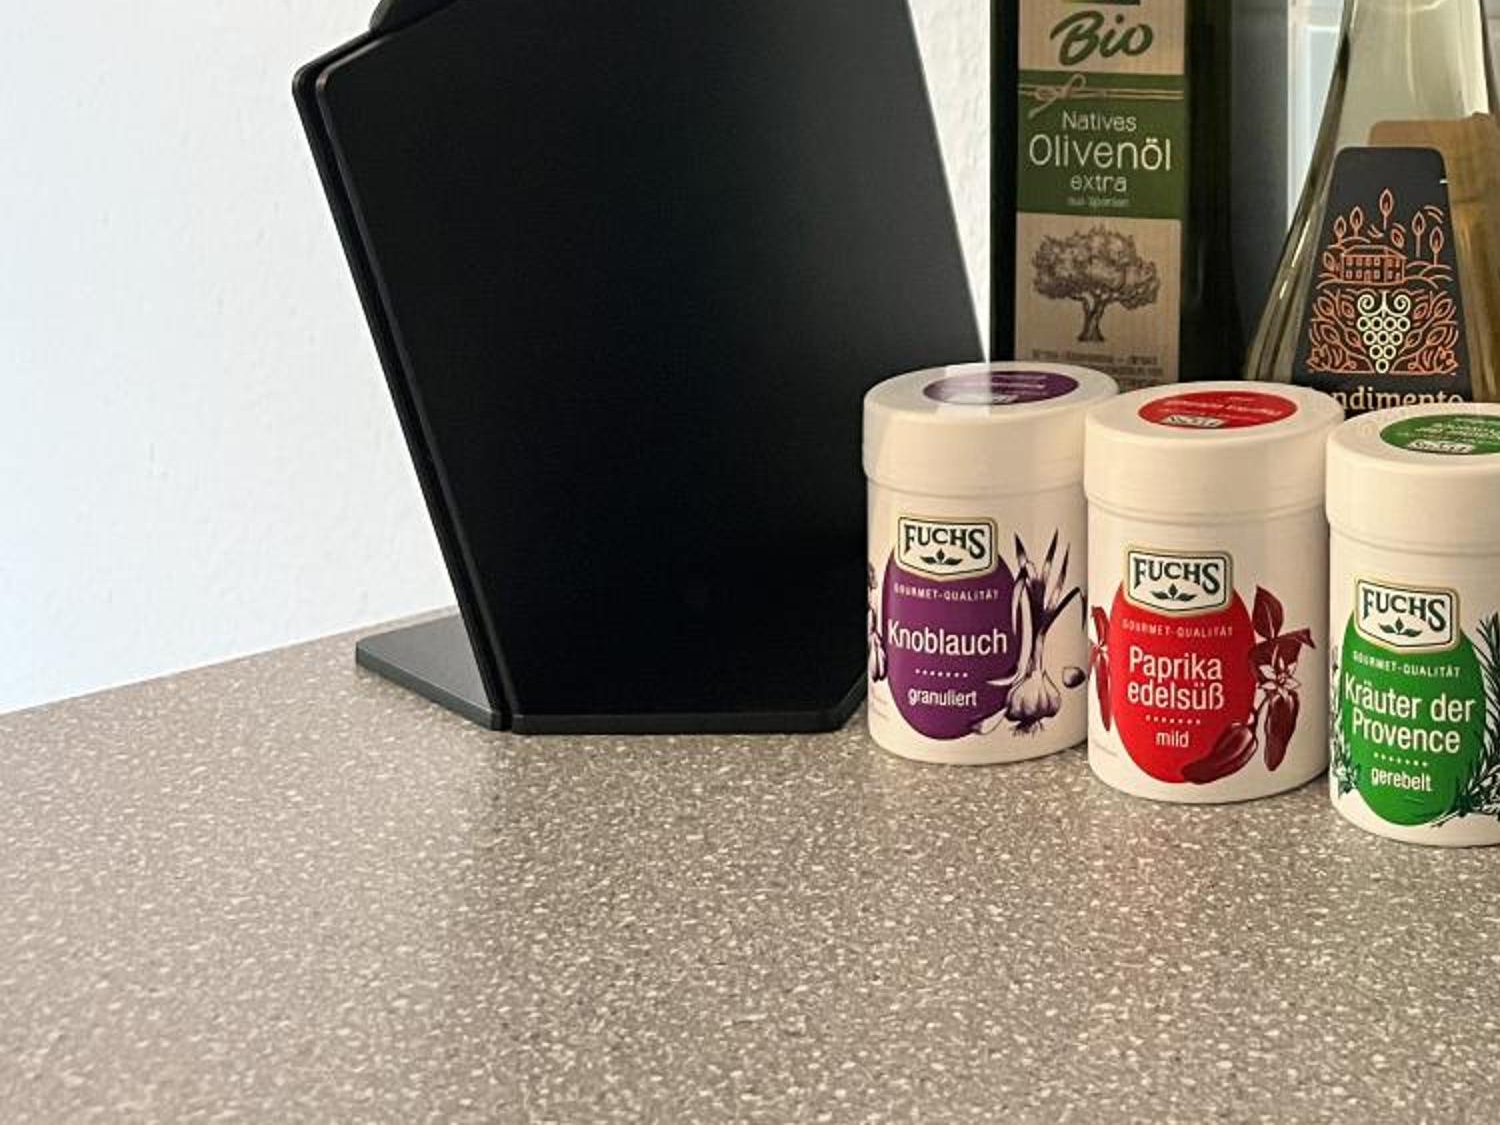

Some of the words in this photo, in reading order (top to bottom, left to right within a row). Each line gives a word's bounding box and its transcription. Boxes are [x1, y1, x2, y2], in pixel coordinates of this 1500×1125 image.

[1050, 10, 1154, 66] Bio
[1062, 111, 1137, 132] Natives
[1029, 134, 1171, 171] Olivenöl
[1071, 175, 1127, 193] extra
[1330, 386, 1464, 410] ndimento
[904, 525, 985, 559] FUCHS
[894, 582, 999, 601] GOURMET-QUALITÄT
[1133, 558, 1220, 595] FUCHS
[1362, 588, 1447, 632] FUCHS
[887, 619, 1007, 655] Knoblauch
[1129, 646, 1223, 683] Paprika
[1353, 650, 1461, 678] GOURMET-QUALITÄT
[908, 687, 977, 706] granuliert
[1127, 680, 1224, 710] edelsüß
[1345, 672, 1422, 719] Kräuter
[1430, 693, 1475, 723] der
[1156, 731, 1189, 748] mild
[1352, 709, 1461, 753] Provence
[1371, 767, 1434, 793] gerebelt
